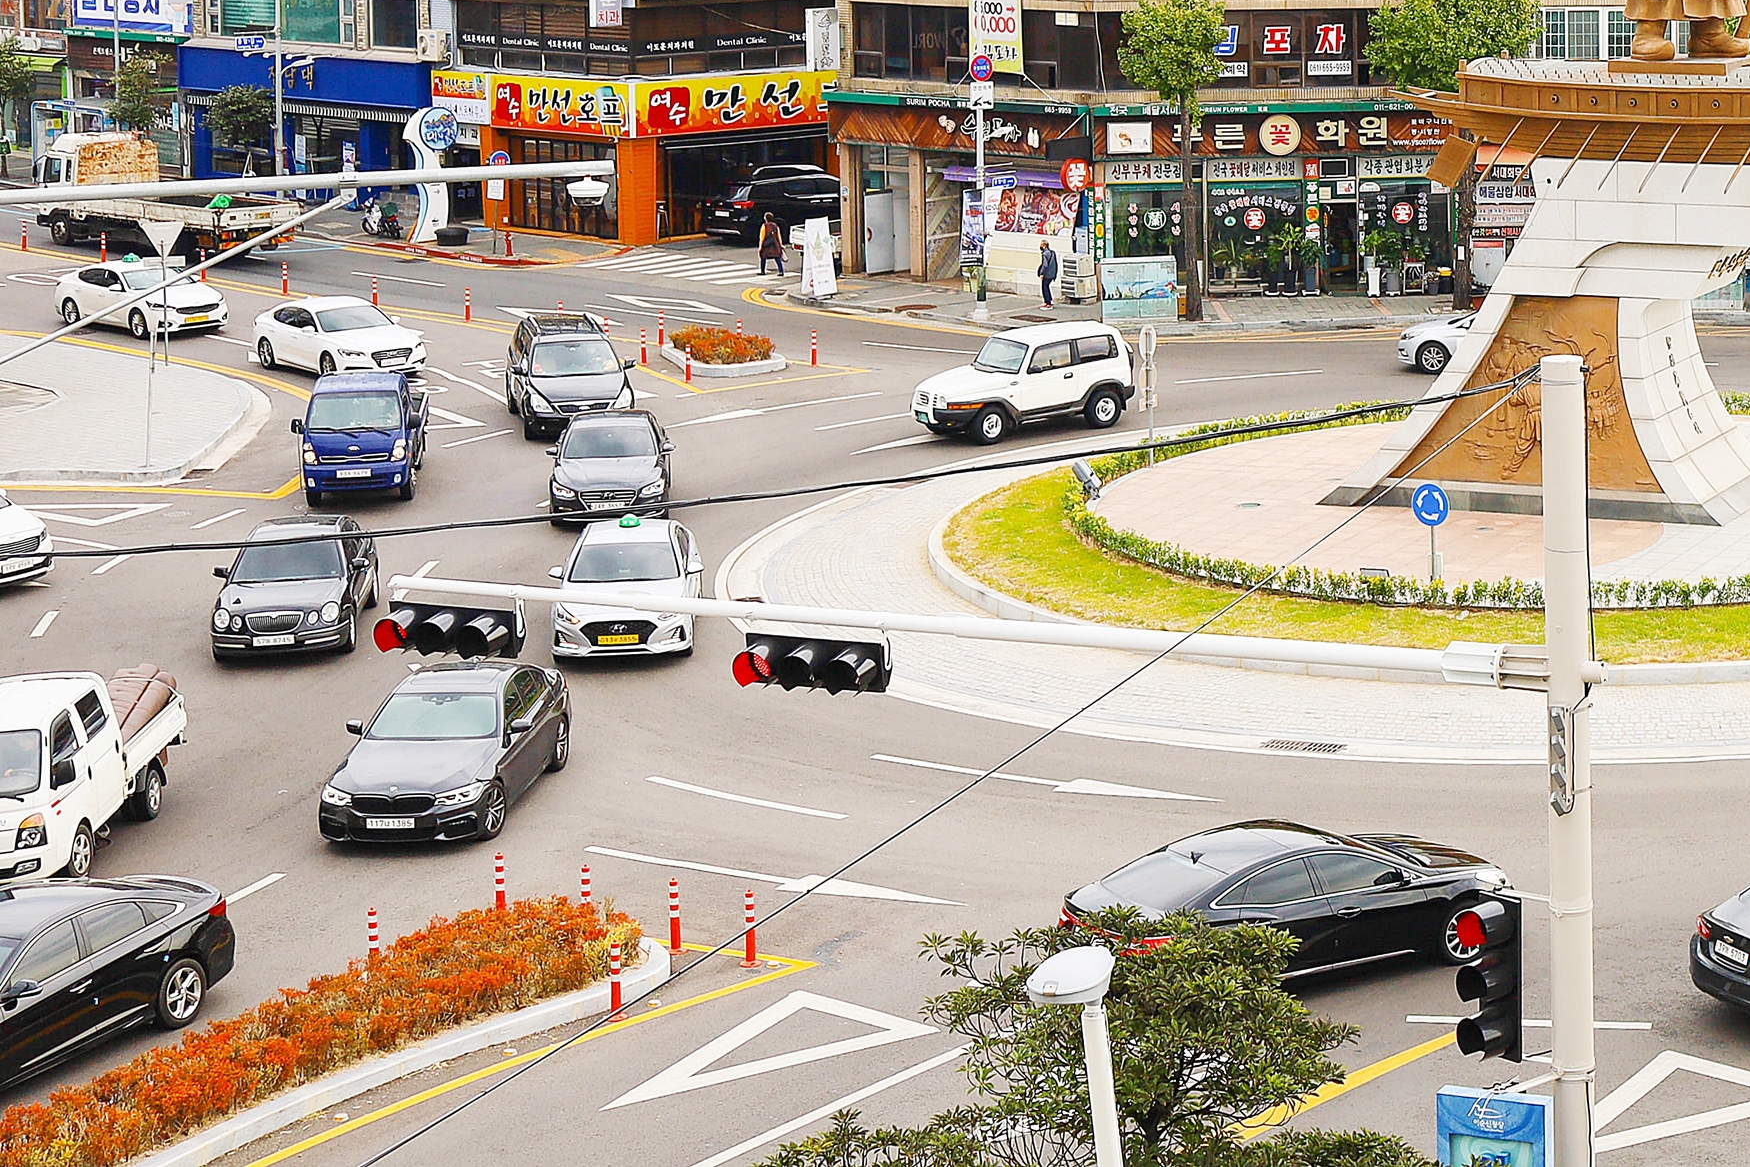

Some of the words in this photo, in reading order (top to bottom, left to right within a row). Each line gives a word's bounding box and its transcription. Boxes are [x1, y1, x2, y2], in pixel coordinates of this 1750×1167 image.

[598, 10, 620, 24] 치과
[502, 37, 522, 45] Dental
[589, 42, 610, 51] Dental
[717, 37, 743, 47] Dental
[745, 36, 767, 45] Clinic
[497, 86, 520, 119] 여수
[528, 88, 623, 125] 만선호프
[651, 91, 687, 125] 여수
[906, 97, 927, 107] SURIM
[928, 98, 951, 108] POCHA
[1109, 105, 1128, 116] 전국
[1142, 104, 1183, 116] 배달서비
[1374, 103, 1416, 111] 011-621-00
[1269, 124, 1292, 146] 꽃
[1315, 116, 1388, 147] 화원
[1111, 164, 1131, 180] 신부
[1153, 163, 1182, 179] 전문점
[1213, 162, 1227, 178] 전국
[1228, 162, 1251, 178] 꽃배달
[1364, 159, 1383, 175] 각종
[1405, 158, 1423, 172] 화분
[1068, 164, 1087, 188] 꽃
[1246, 209, 1264, 229] 꽃
[1394, 205, 1411, 221] 꽃
[272, 637, 291, 645] 8745
[1730, 948, 1746, 962] 5703
